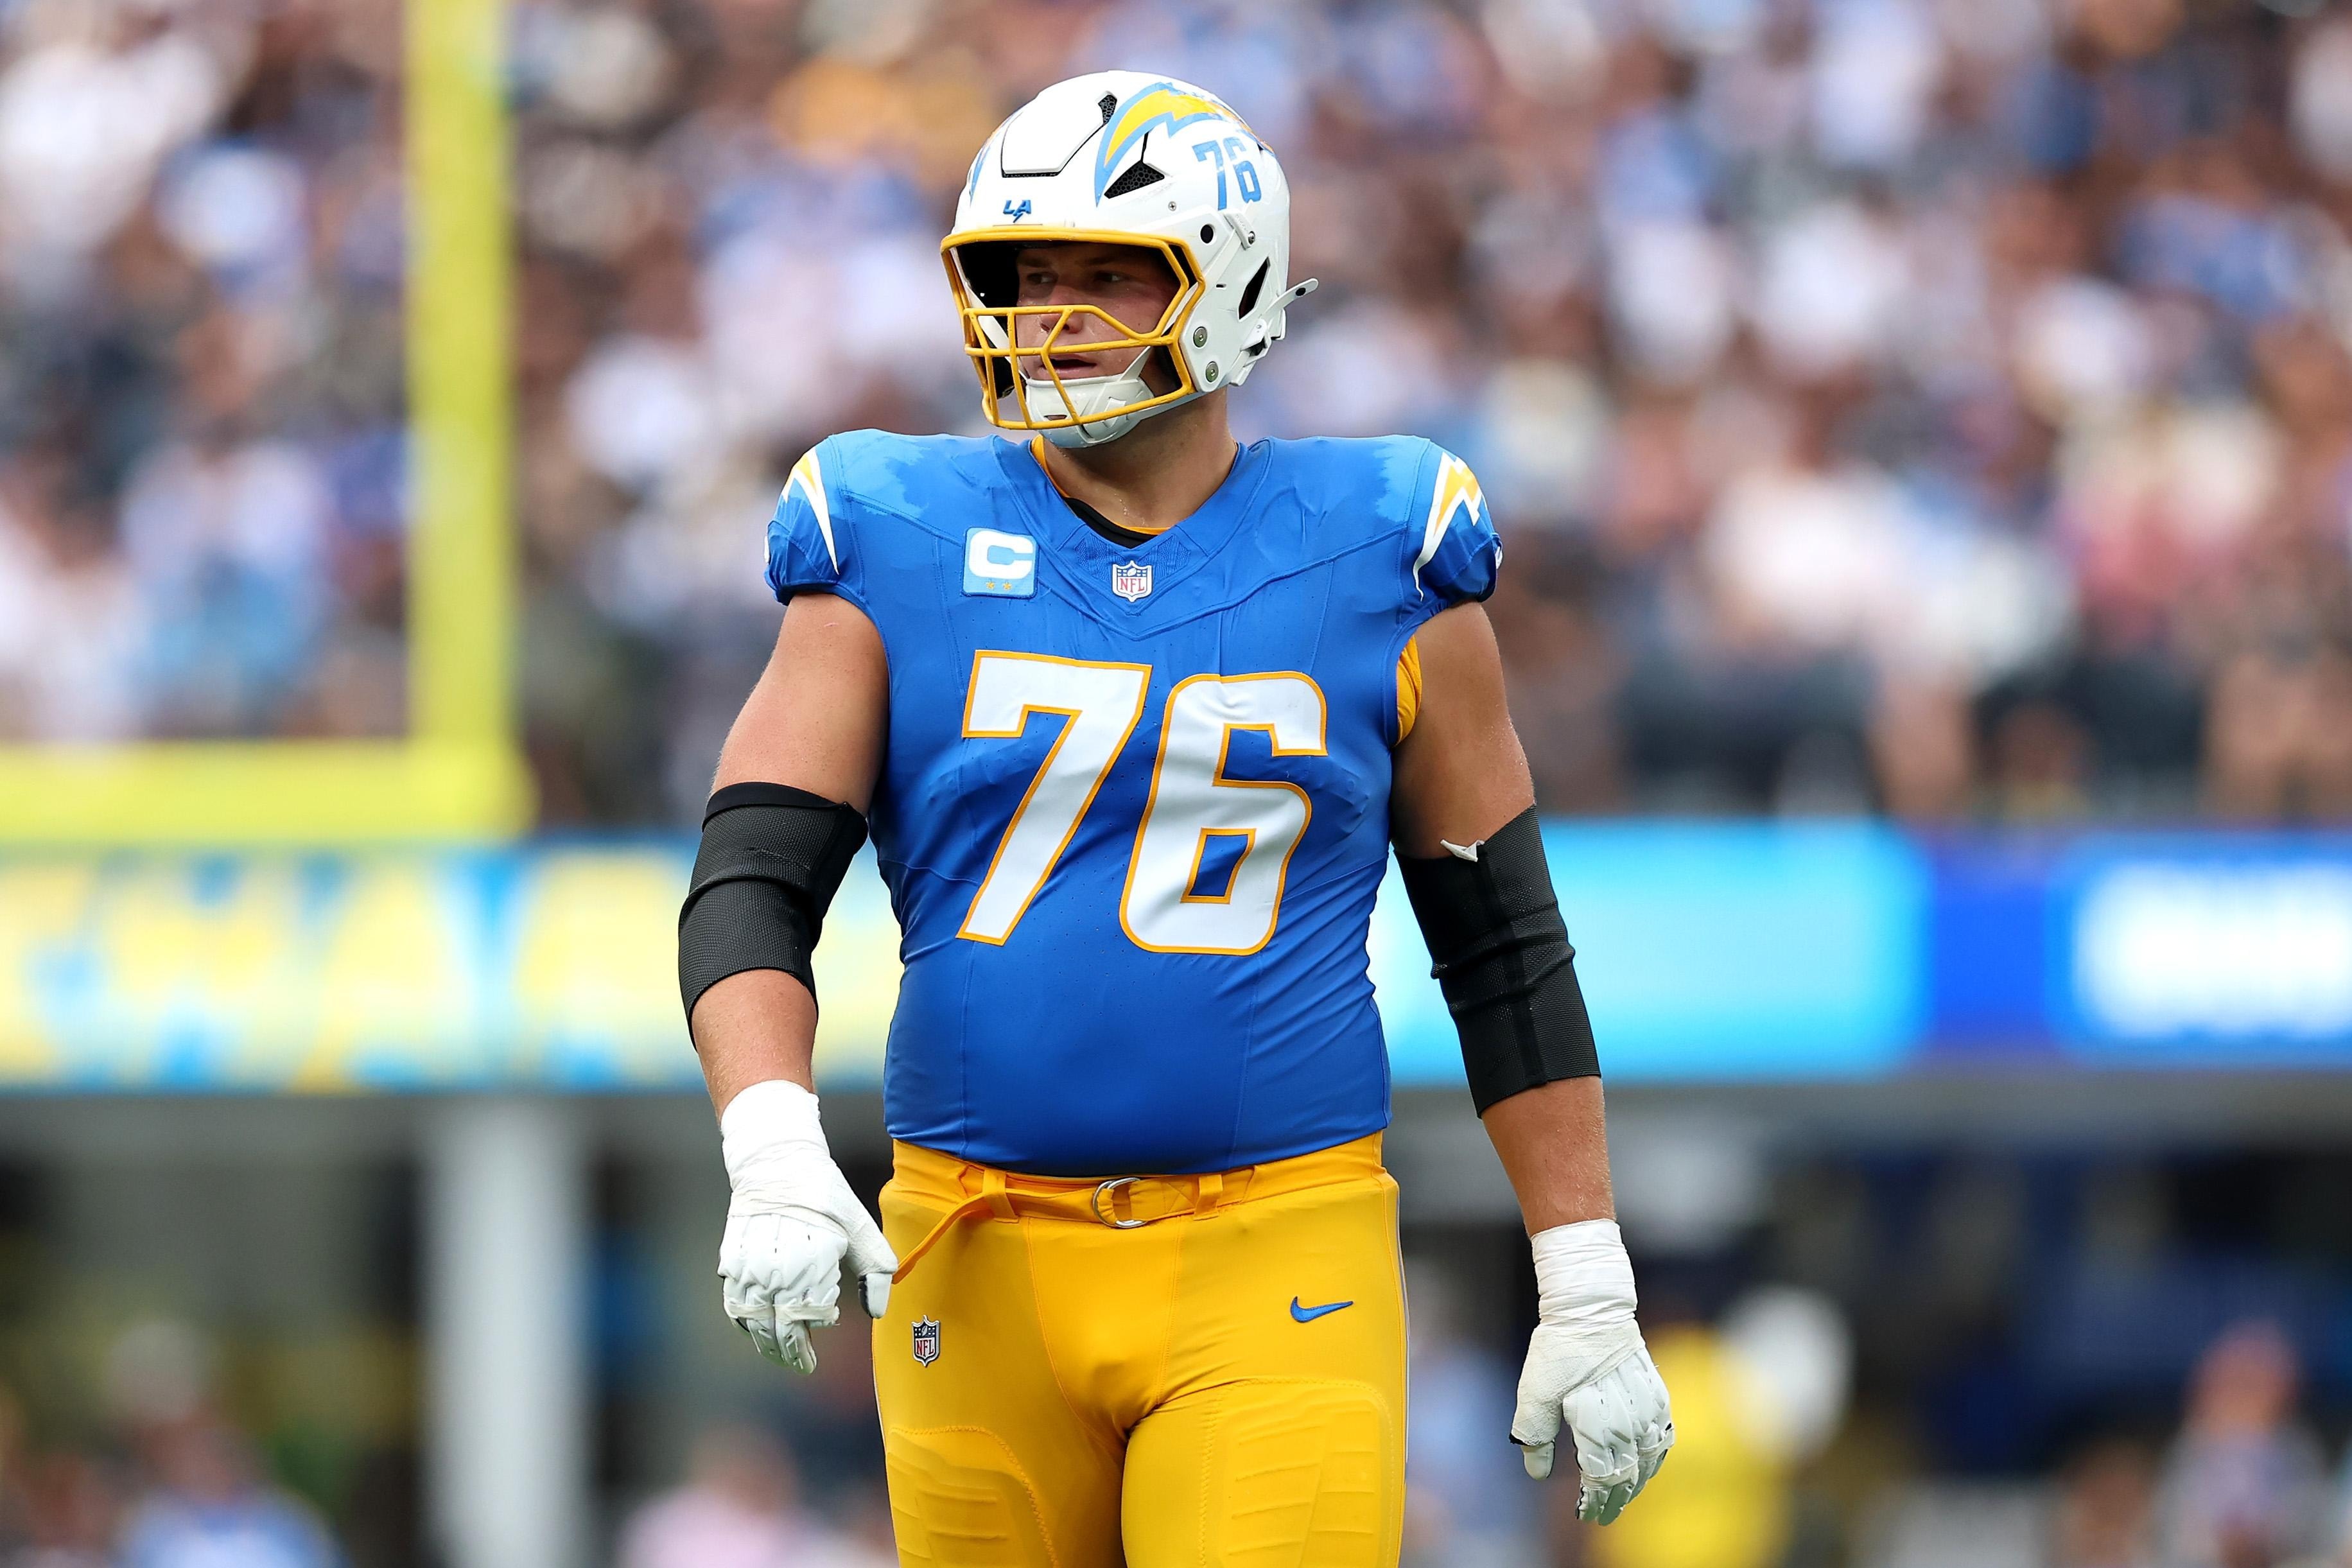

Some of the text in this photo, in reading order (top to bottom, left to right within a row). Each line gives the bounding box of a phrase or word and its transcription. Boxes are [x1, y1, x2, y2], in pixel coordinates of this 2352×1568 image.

[1192, 137, 1262, 211] 76
[1003, 200, 1031, 219] LA
[968, 530, 1033, 579] C
[1119, 578, 1145, 593] NFL
[956, 650, 1328, 955] 76
[916, 1339, 934, 1357] NFL
